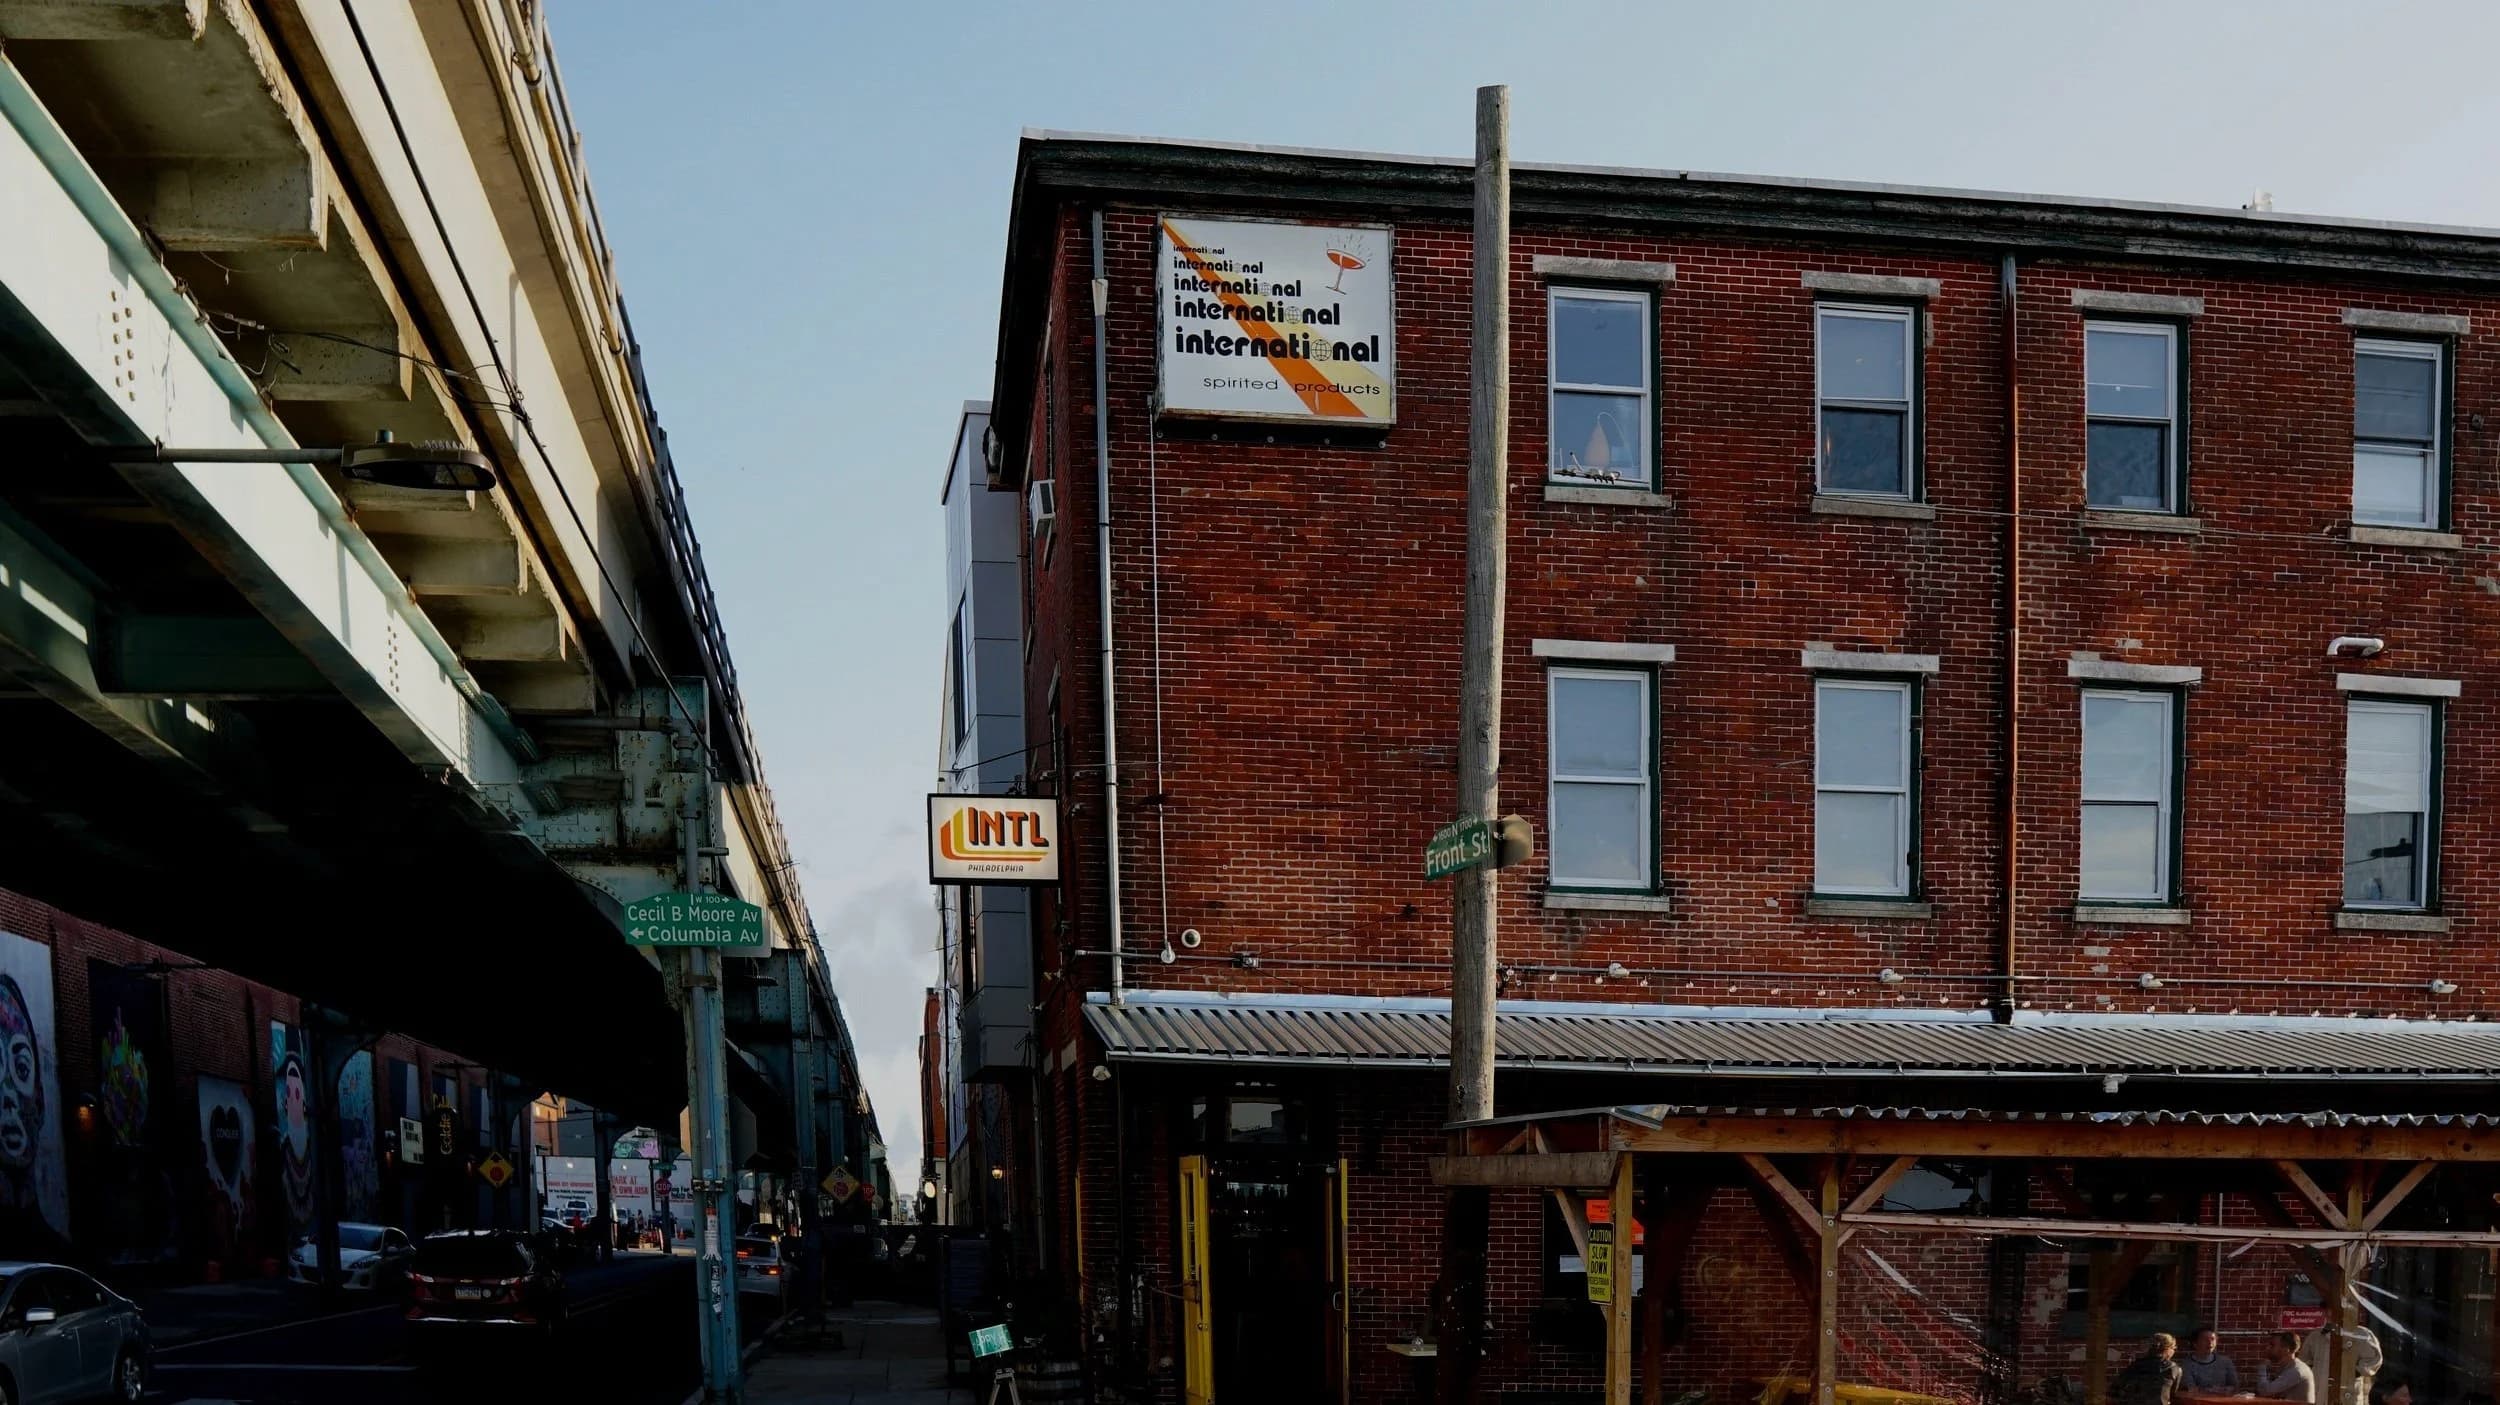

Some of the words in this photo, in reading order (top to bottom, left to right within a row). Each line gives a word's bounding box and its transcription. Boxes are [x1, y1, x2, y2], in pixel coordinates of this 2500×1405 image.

[1173, 244, 1225, 255] international
[1173, 257, 1264, 274] international
[1173, 273, 1302, 297] international
[1174, 296, 1341, 326] international
[1175, 325, 1379, 363] international
[1203, 376, 1279, 390] spirited
[1293, 382, 1381, 395] products
[967, 806, 1050, 847] INTL
[1426, 835, 1467, 877] Front
[1471, 831, 1488, 858] St
[968, 864, 1024, 873] PHILADELPHIA
[695, 896, 702, 904] W
[705, 896, 721, 904] 100
[627, 905, 666, 922] Cecil
[671, 906, 682, 922] B
[688, 906, 736, 923] Moore
[741, 908, 759, 923] Av
[647, 925, 732, 943] Columbia
[739, 929, 759, 944] Av
[656, 1183, 671, 1191] STOP
[1589, 1229, 1612, 1242] CAUTION
[1591, 1246, 1608, 1260] SLOW
[1590, 1261, 1608, 1275] DOWN
